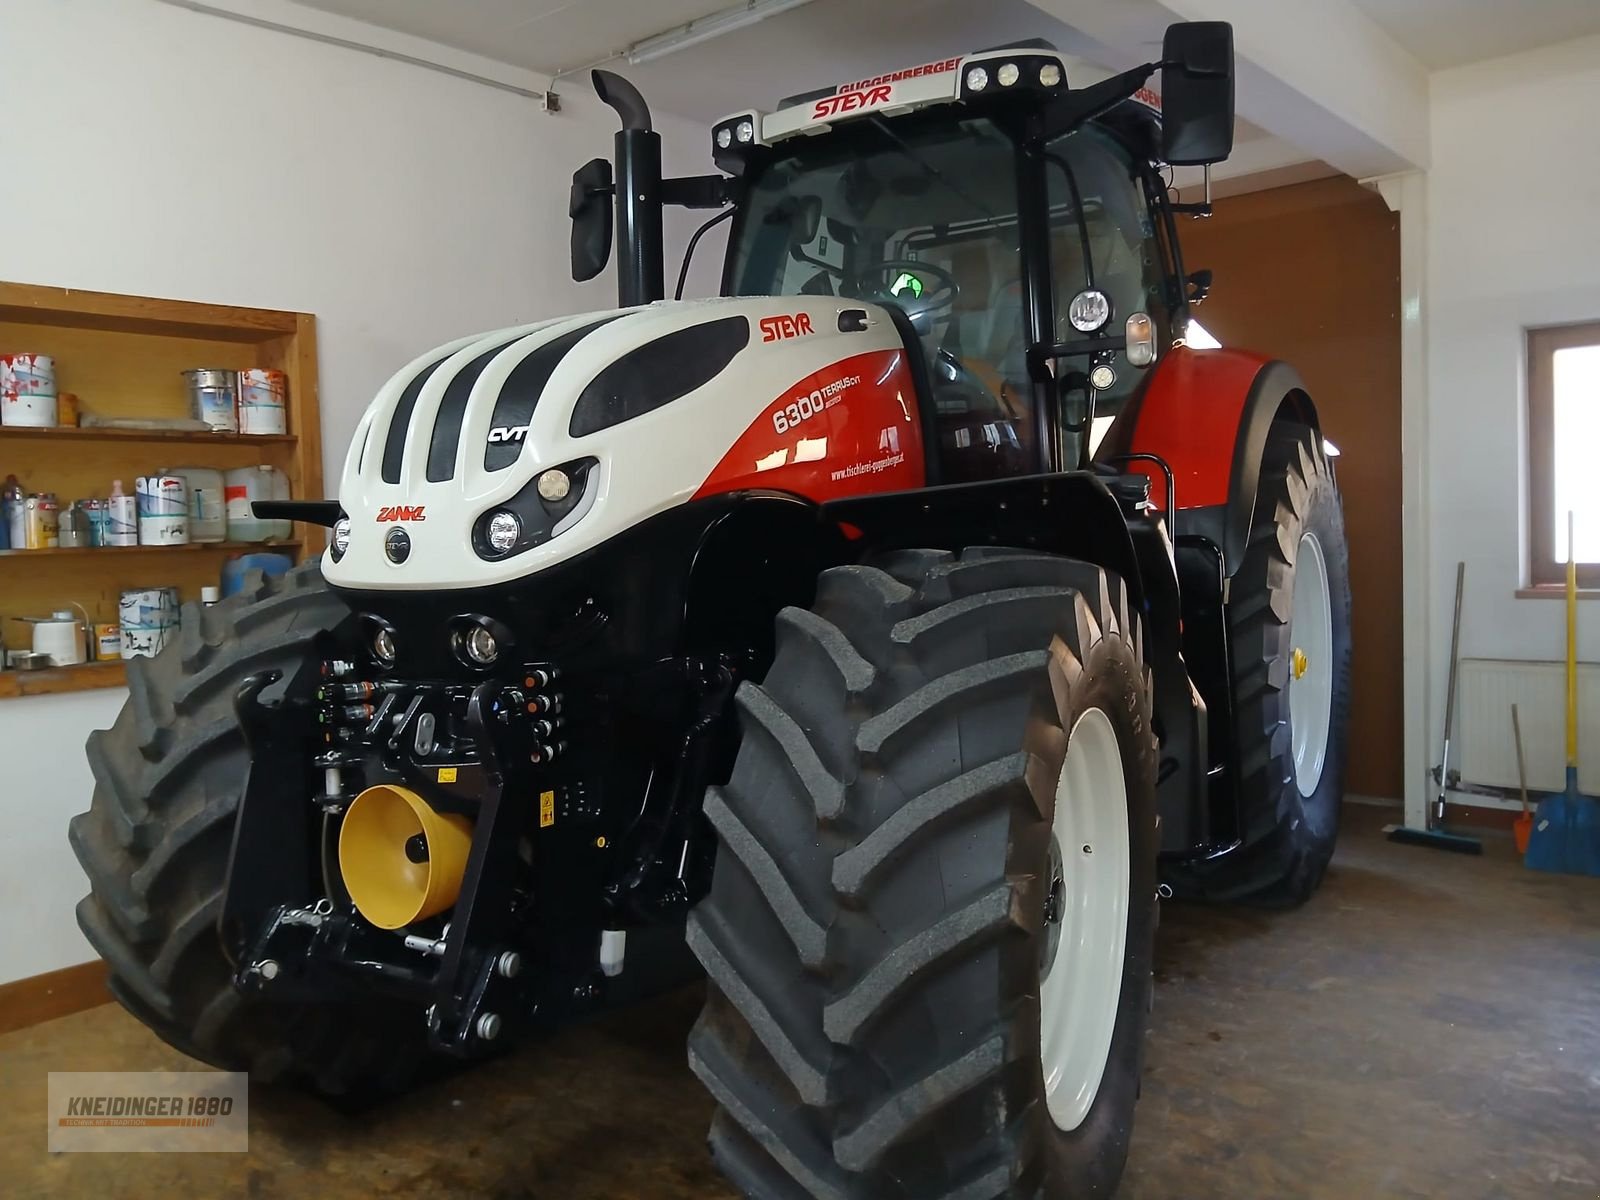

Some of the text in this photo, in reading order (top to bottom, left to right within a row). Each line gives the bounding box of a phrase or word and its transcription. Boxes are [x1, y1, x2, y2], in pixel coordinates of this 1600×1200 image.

[812, 85, 892, 119] STEYR
[760, 313, 815, 342] STEYR
[773, 391, 824, 433] 6300
[487, 426, 530, 442] CVT
[376, 506, 426, 522] ZANKL
